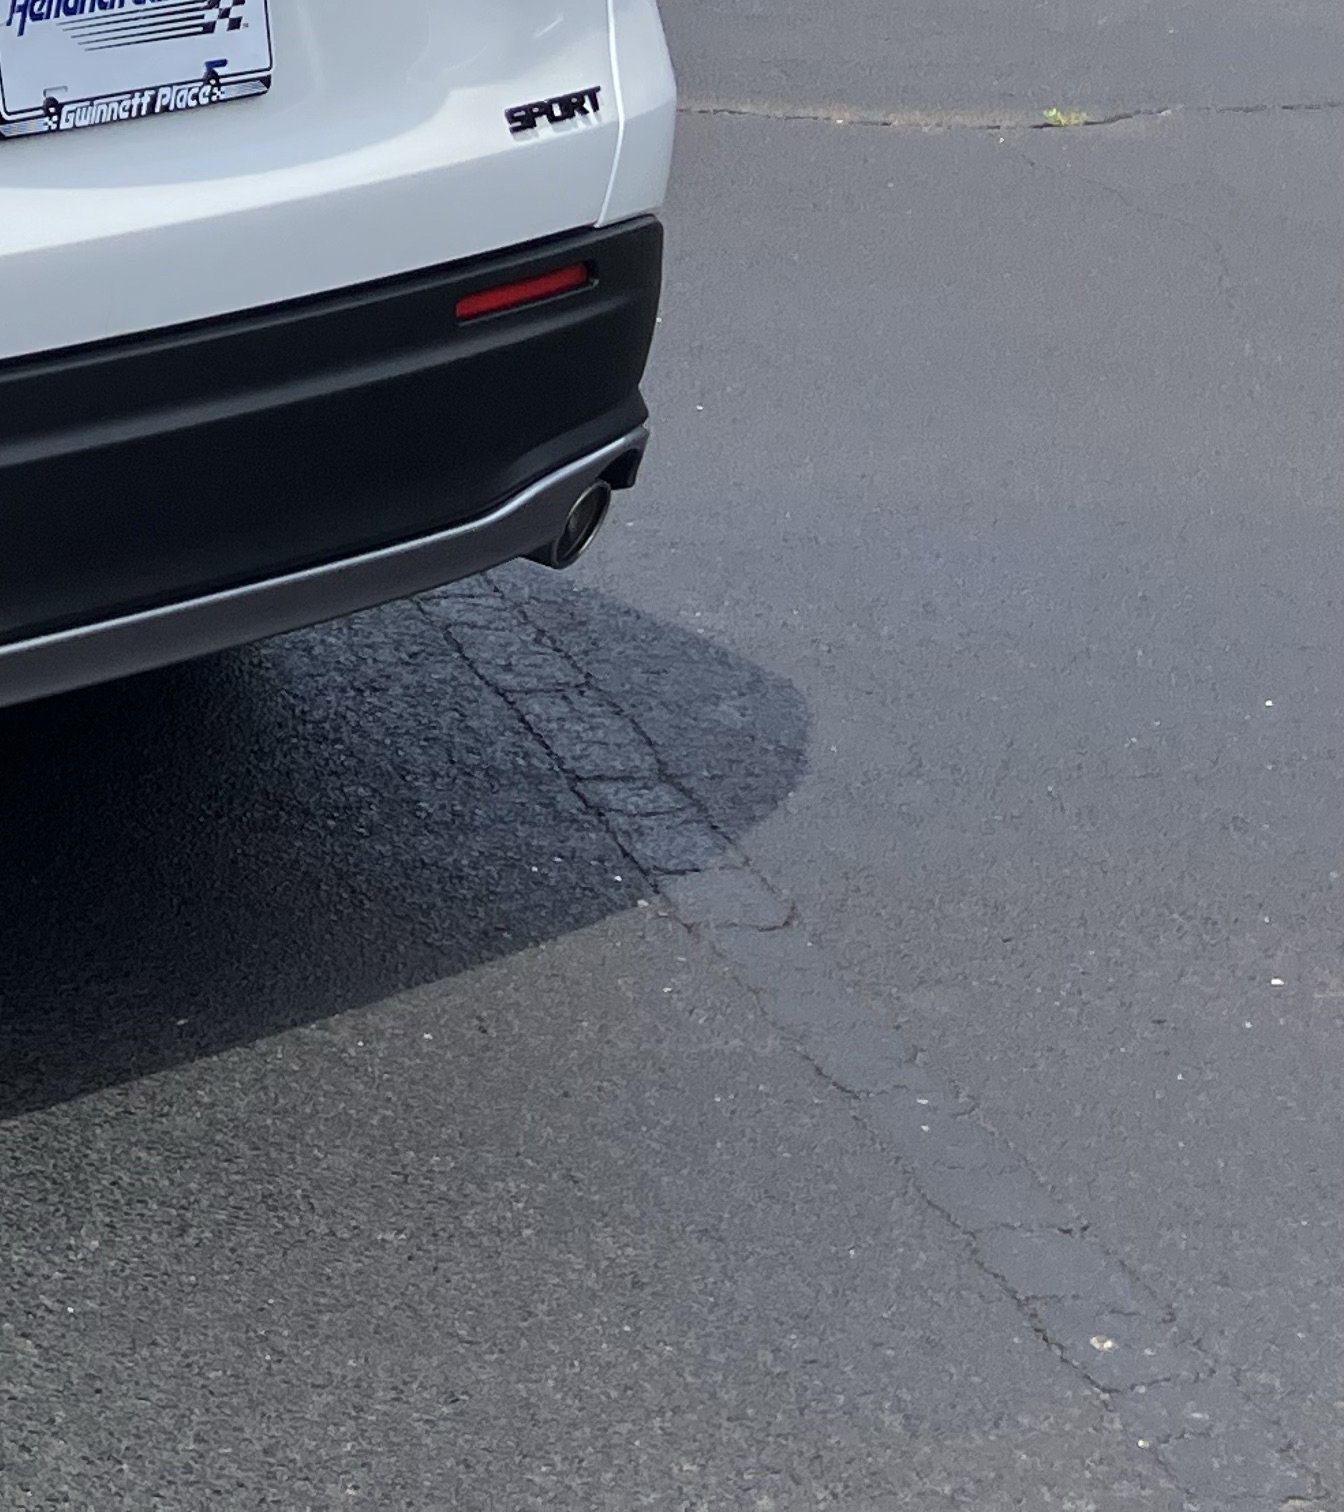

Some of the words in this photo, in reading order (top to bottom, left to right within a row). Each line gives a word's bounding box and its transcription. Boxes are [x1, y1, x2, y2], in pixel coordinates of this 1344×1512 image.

[59, 89, 156, 130] Gwinnett
[155, 84, 212, 114] Place
[504, 85, 601, 134] SPORT
